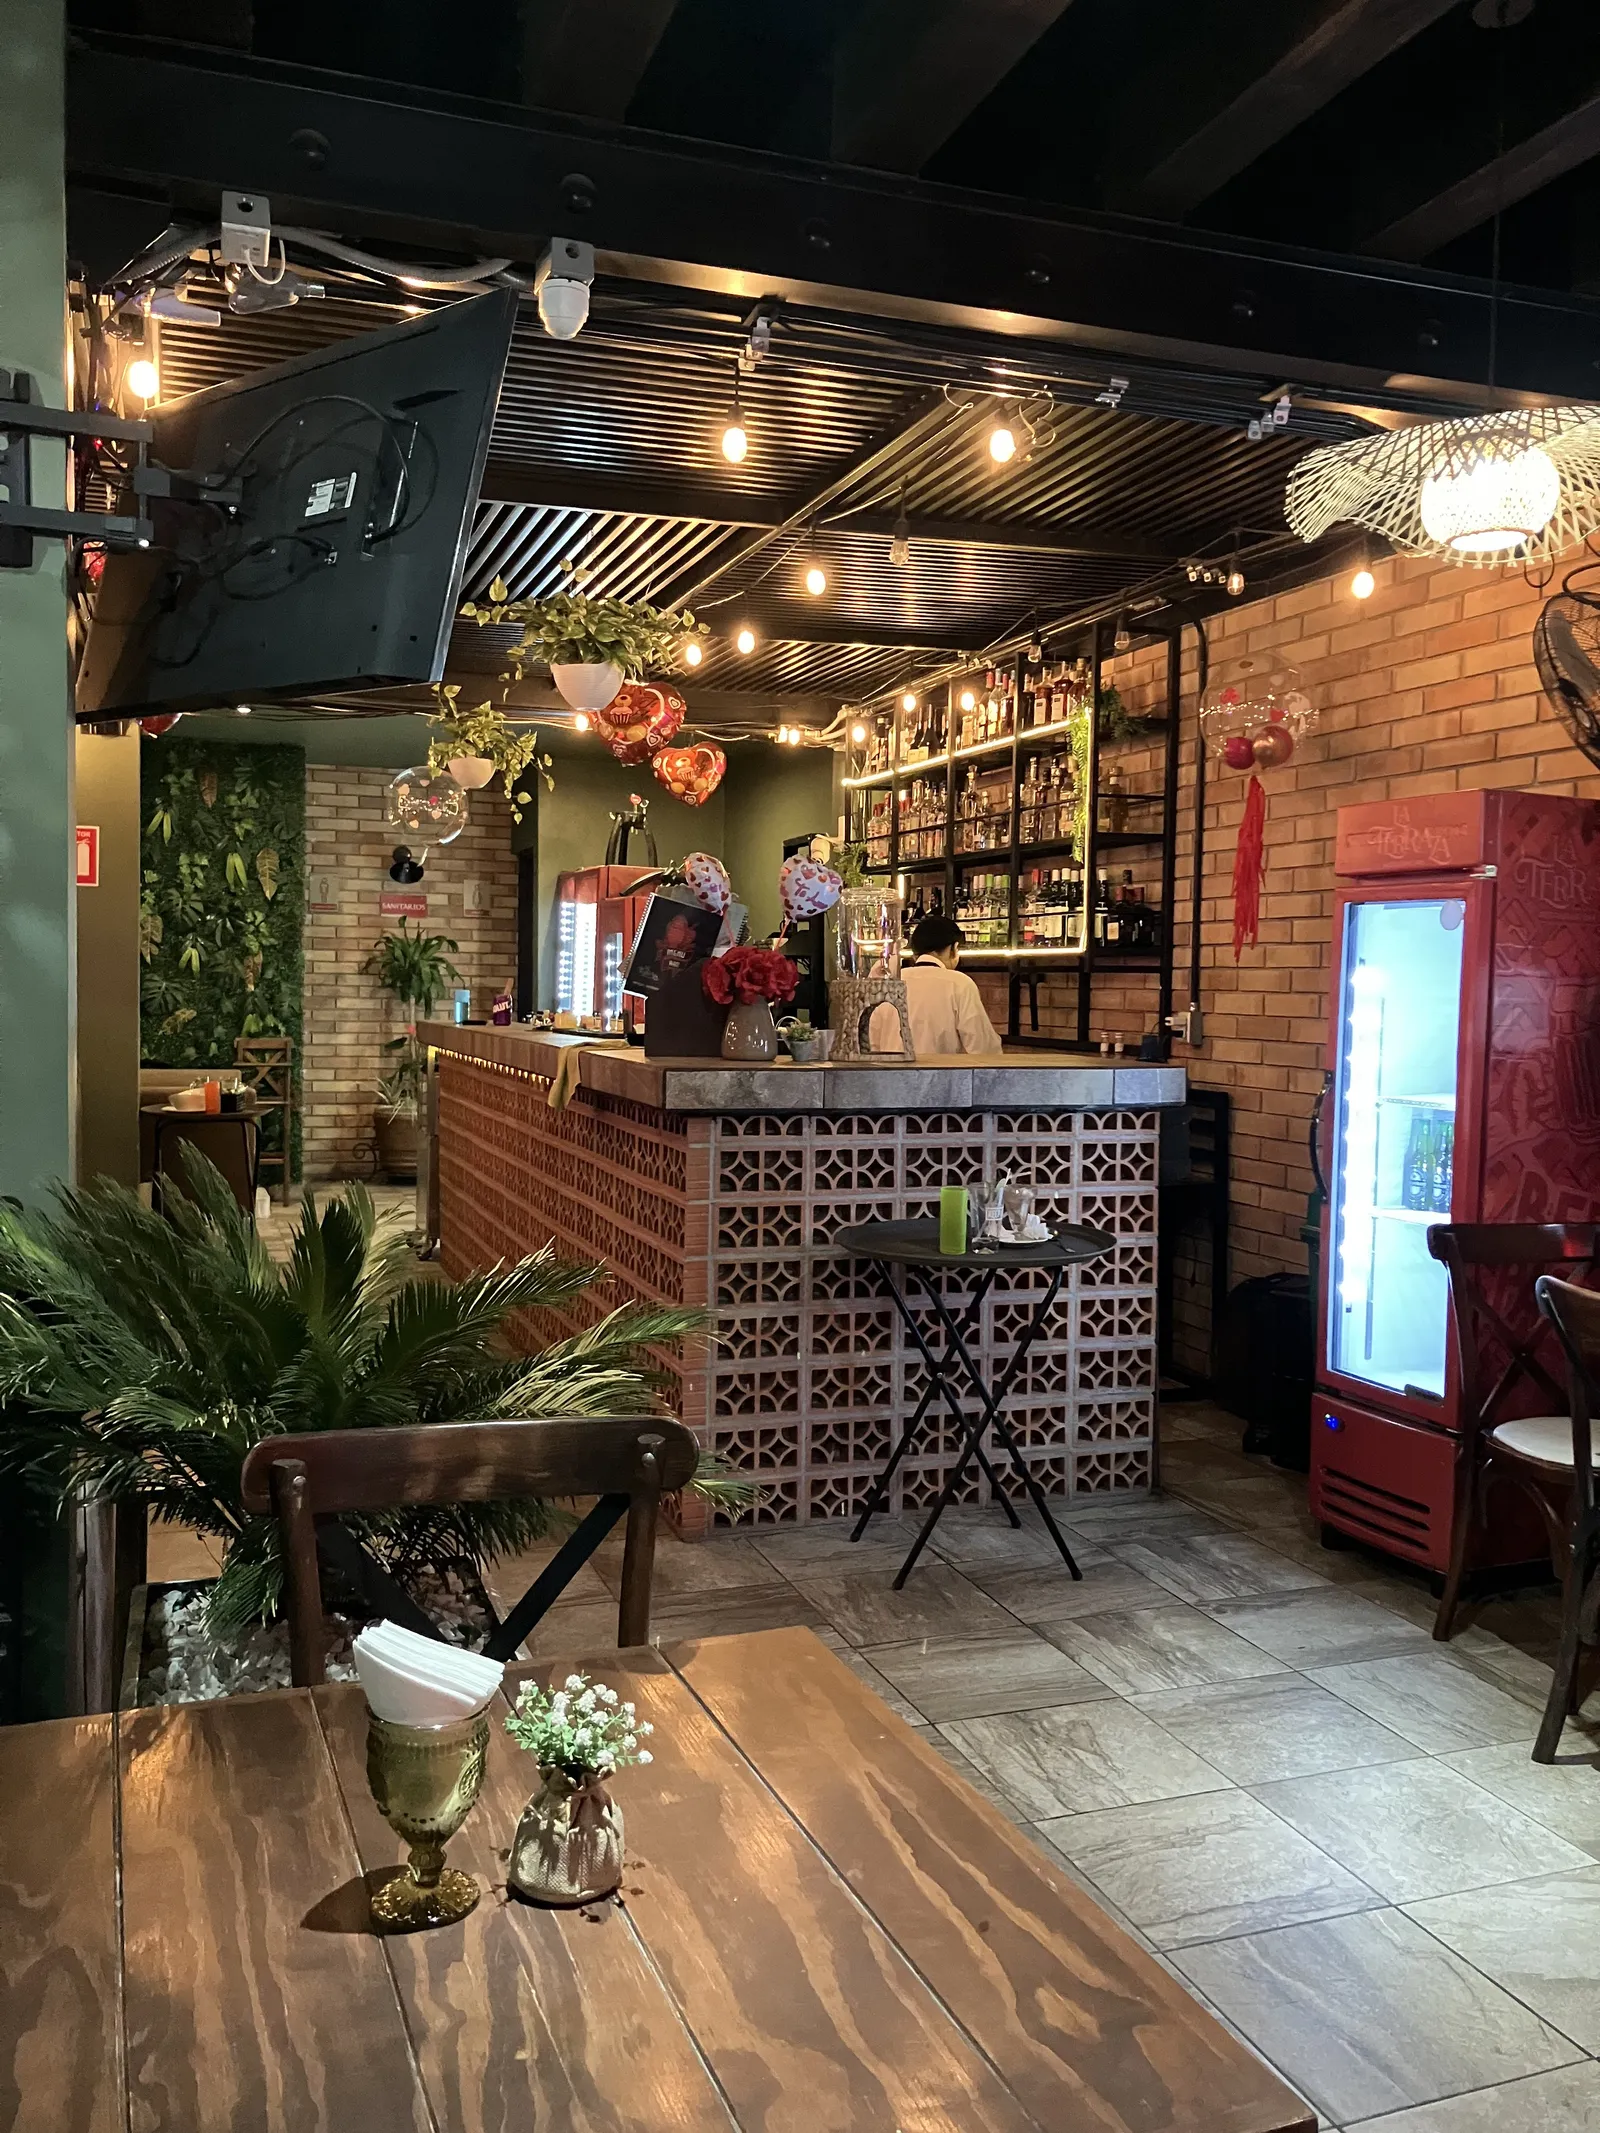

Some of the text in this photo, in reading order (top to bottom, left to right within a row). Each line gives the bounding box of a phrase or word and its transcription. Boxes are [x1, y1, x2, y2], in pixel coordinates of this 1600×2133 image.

[1393, 804, 1411, 827] LA
[1514, 858, 1593, 909] TERR
[382, 902, 426, 911] SANITARIOS
